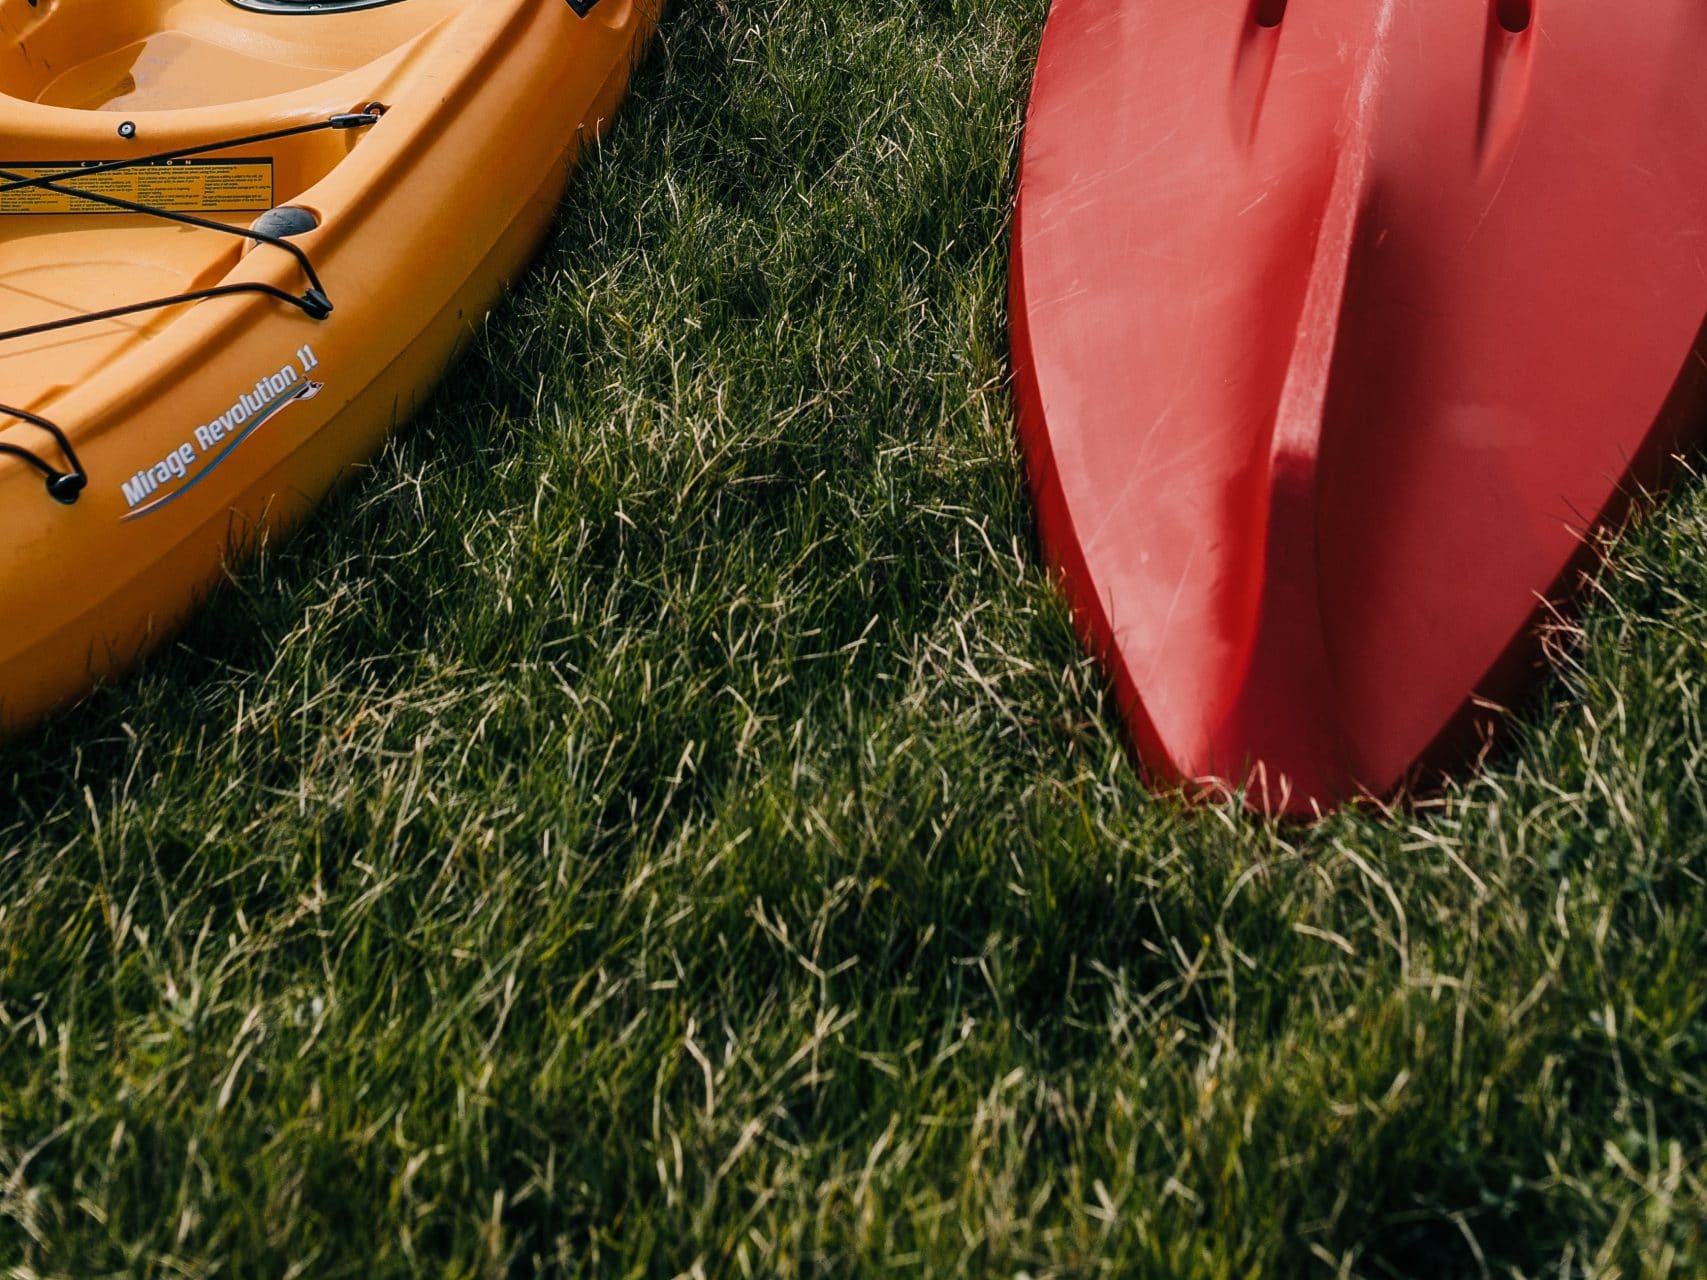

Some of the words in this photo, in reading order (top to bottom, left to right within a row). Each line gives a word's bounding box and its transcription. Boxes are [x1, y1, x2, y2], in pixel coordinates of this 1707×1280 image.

[121, 442, 196, 507] Mirage
[193, 364, 298, 451] Revolution
[296, 344, 319, 372] 11
